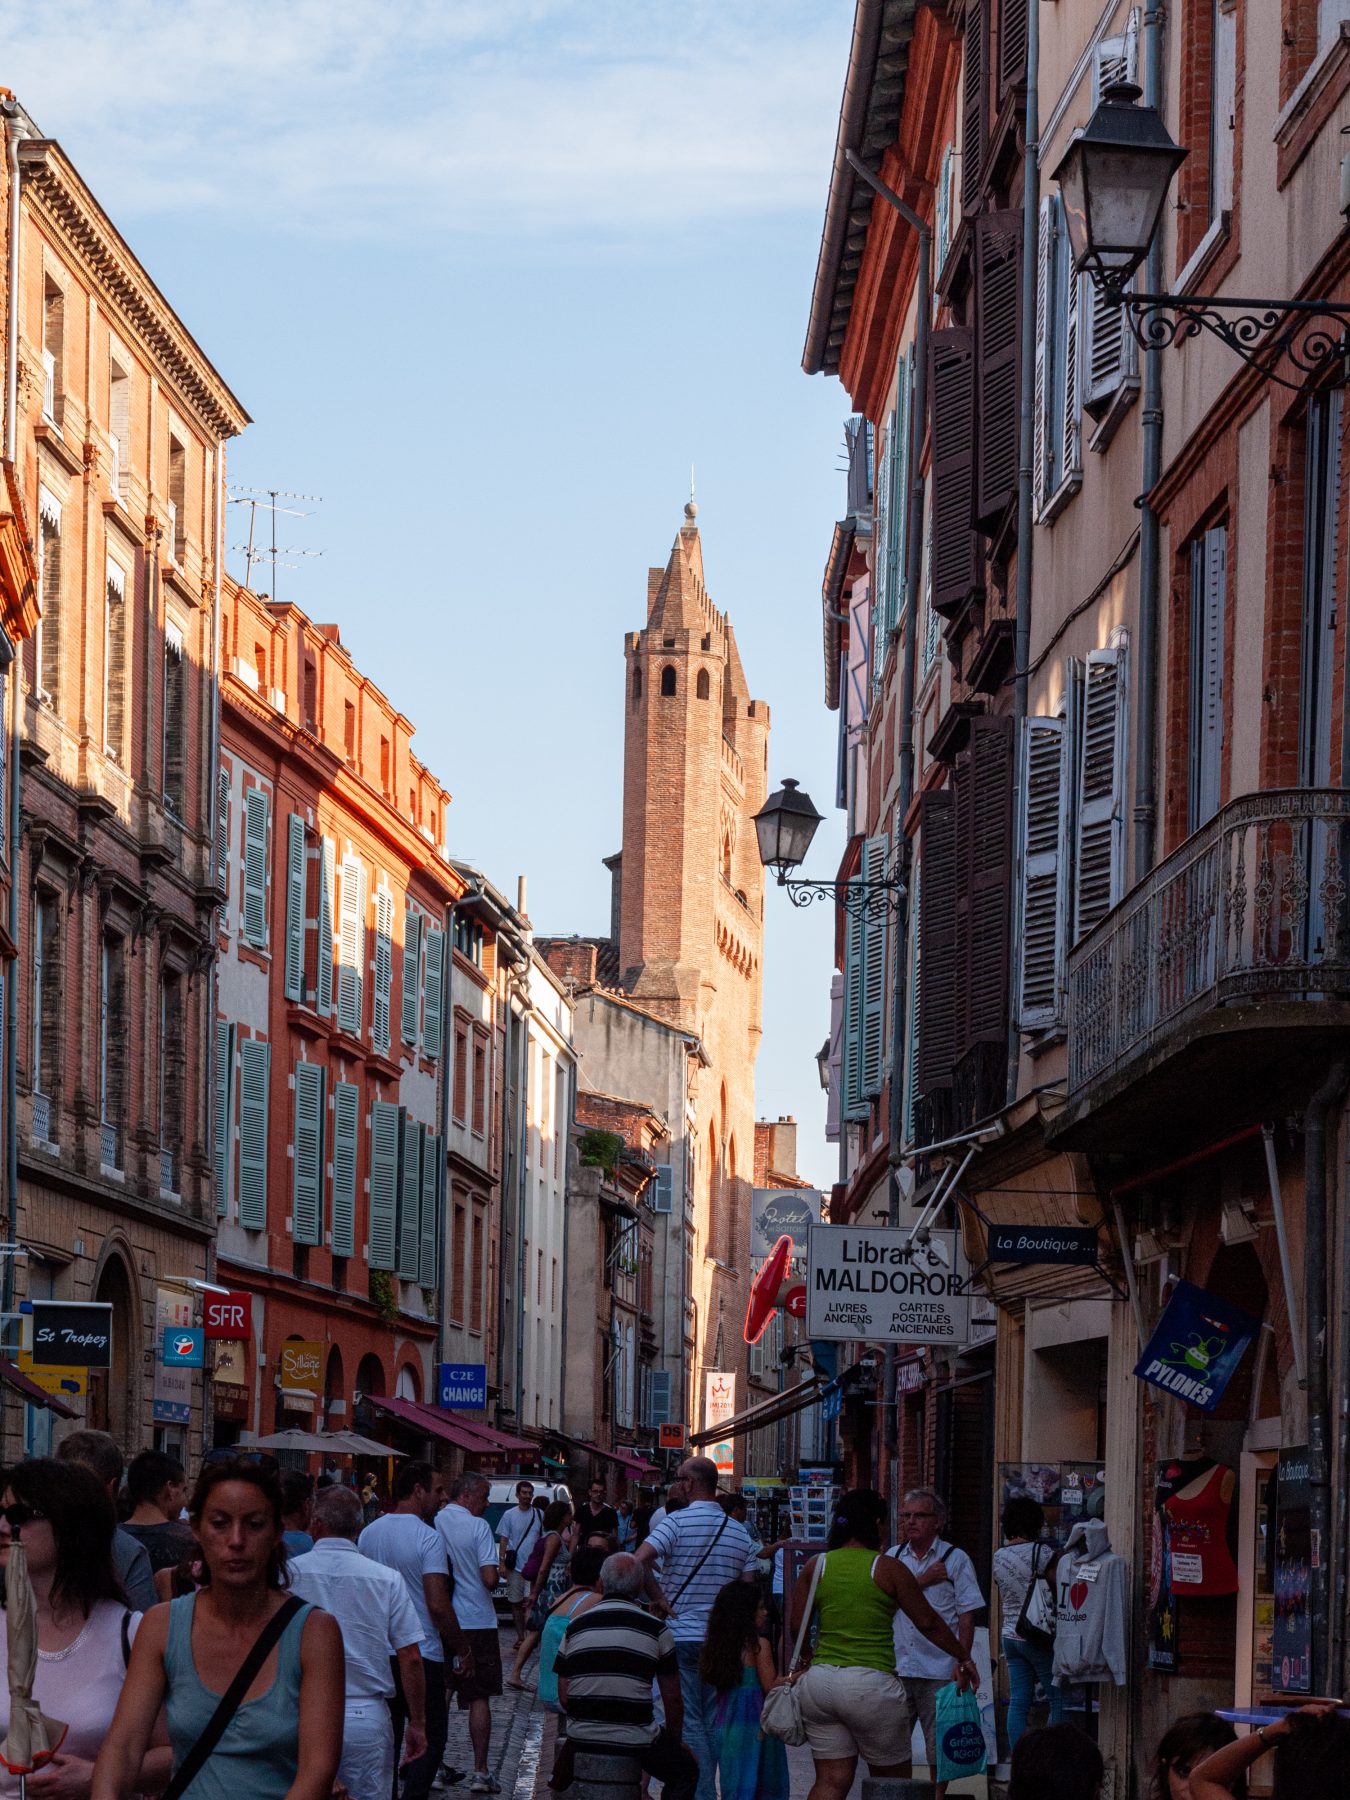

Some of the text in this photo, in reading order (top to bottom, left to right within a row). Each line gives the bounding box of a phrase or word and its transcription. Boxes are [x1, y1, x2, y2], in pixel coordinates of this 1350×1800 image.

[764, 1208, 811, 1229] Pastel
[843, 1240, 942, 1267] Librae
[997, 1235, 1014, 1249] La
[1016, 1236, 1079, 1254] Boutique
[816, 1268, 964, 1297] MALDOROR
[208, 1304, 245, 1328] SFR
[829, 1303, 868, 1314] LIVRES
[899, 1303, 945, 1314] CARTES
[824, 1314, 873, 1325] ANCIENS
[892, 1314, 951, 1325] POSTALES
[36, 1328, 109, 1348] St Tropez
[889, 1325, 955, 1336] ANCIENNES
[284, 1349, 321, 1380] Sillage
[450, 1370, 475, 1381] C2E
[1144, 1359, 1214, 1405] PYLONES
[443, 1387, 484, 1402] CHANGE
[663, 1426, 681, 1437] DS
[1059, 1582, 1069, 1609] I
